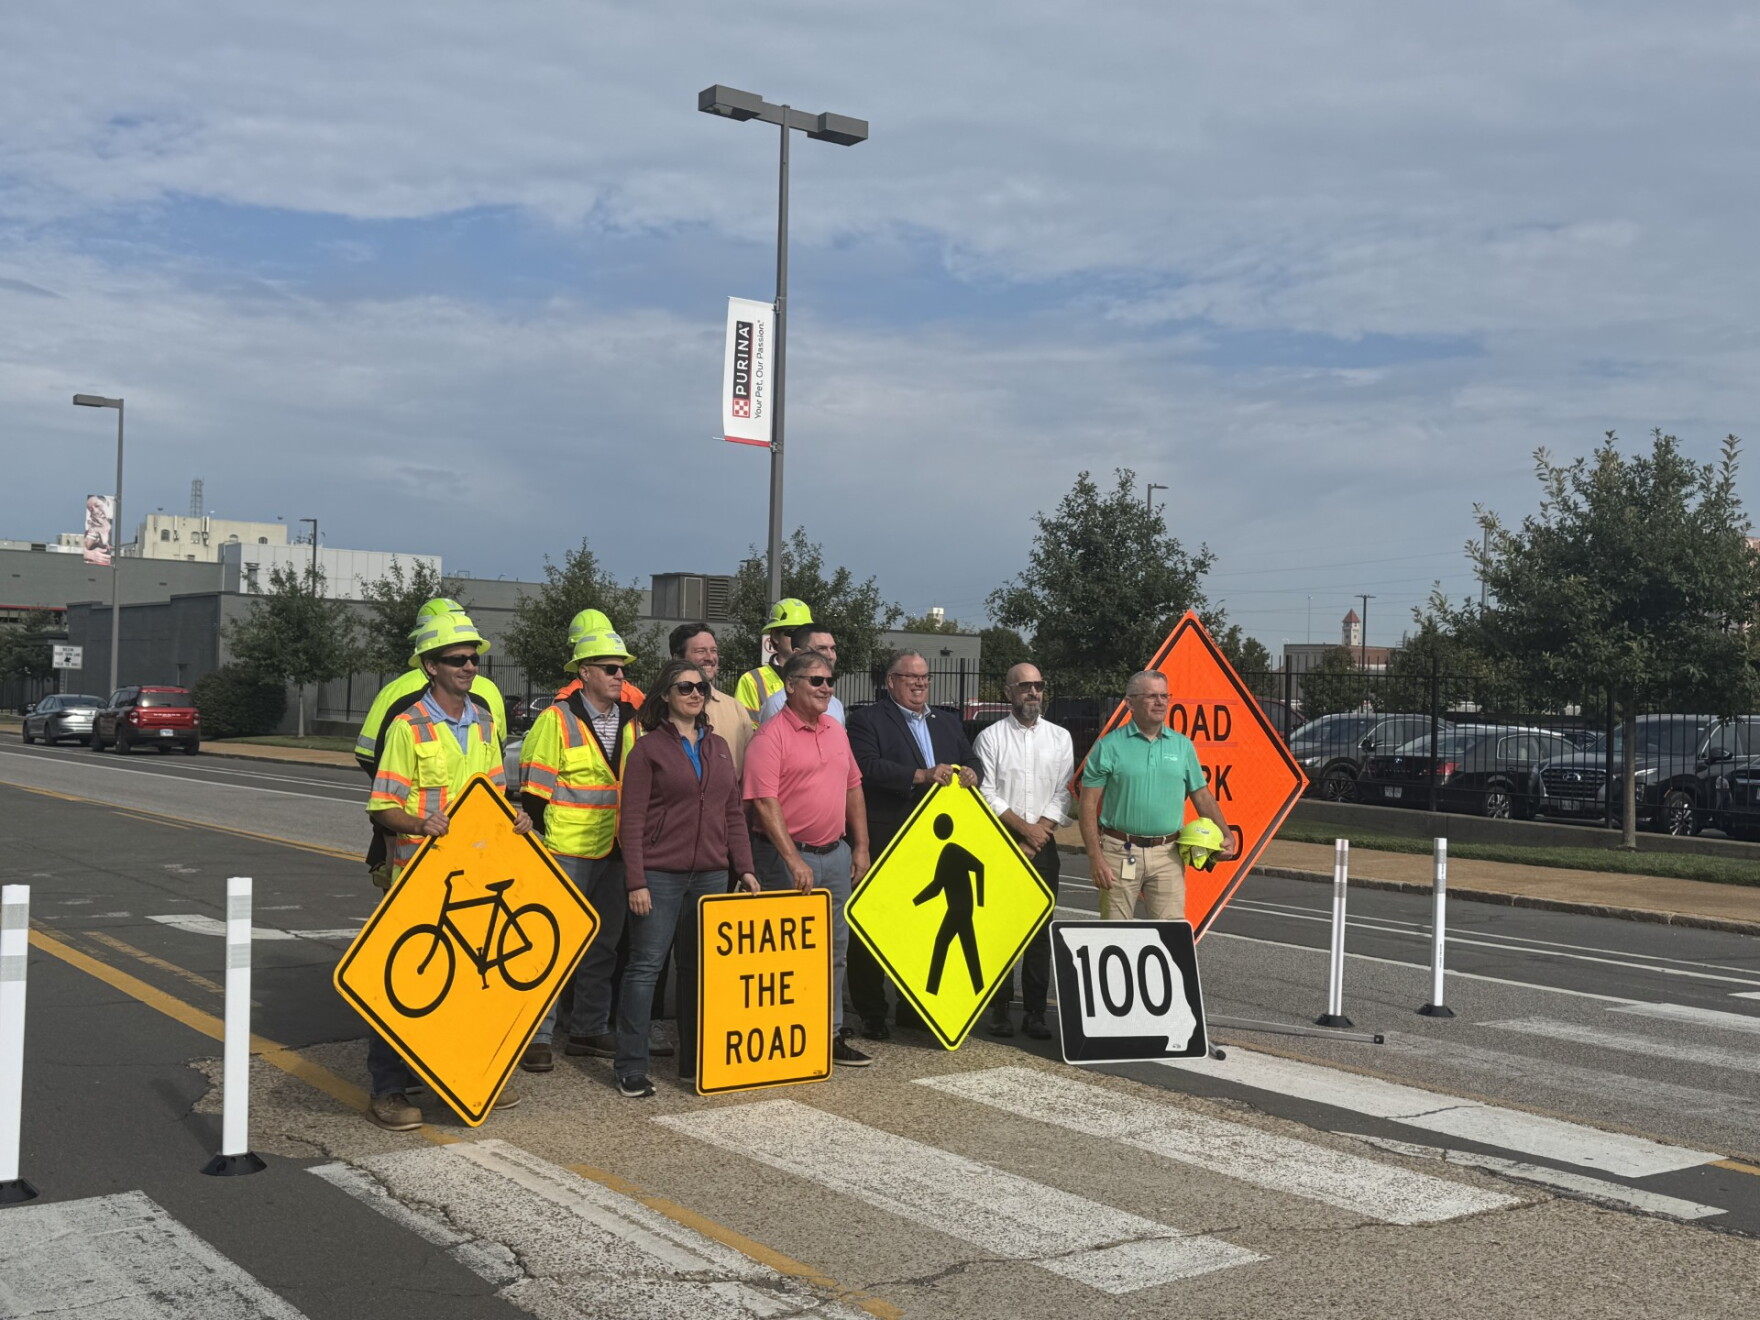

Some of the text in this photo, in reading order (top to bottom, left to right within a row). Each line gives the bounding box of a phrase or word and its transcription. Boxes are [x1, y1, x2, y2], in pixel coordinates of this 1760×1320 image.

[755, 361, 764, 378] Our
[754, 399, 763, 419] Your
[1169, 704, 1232, 742] OAD
[716, 916, 816, 956] SHARE
[739, 970, 795, 1009] THE
[1076, 945, 1173, 1017] 100
[725, 1024, 806, 1065] ROAD
